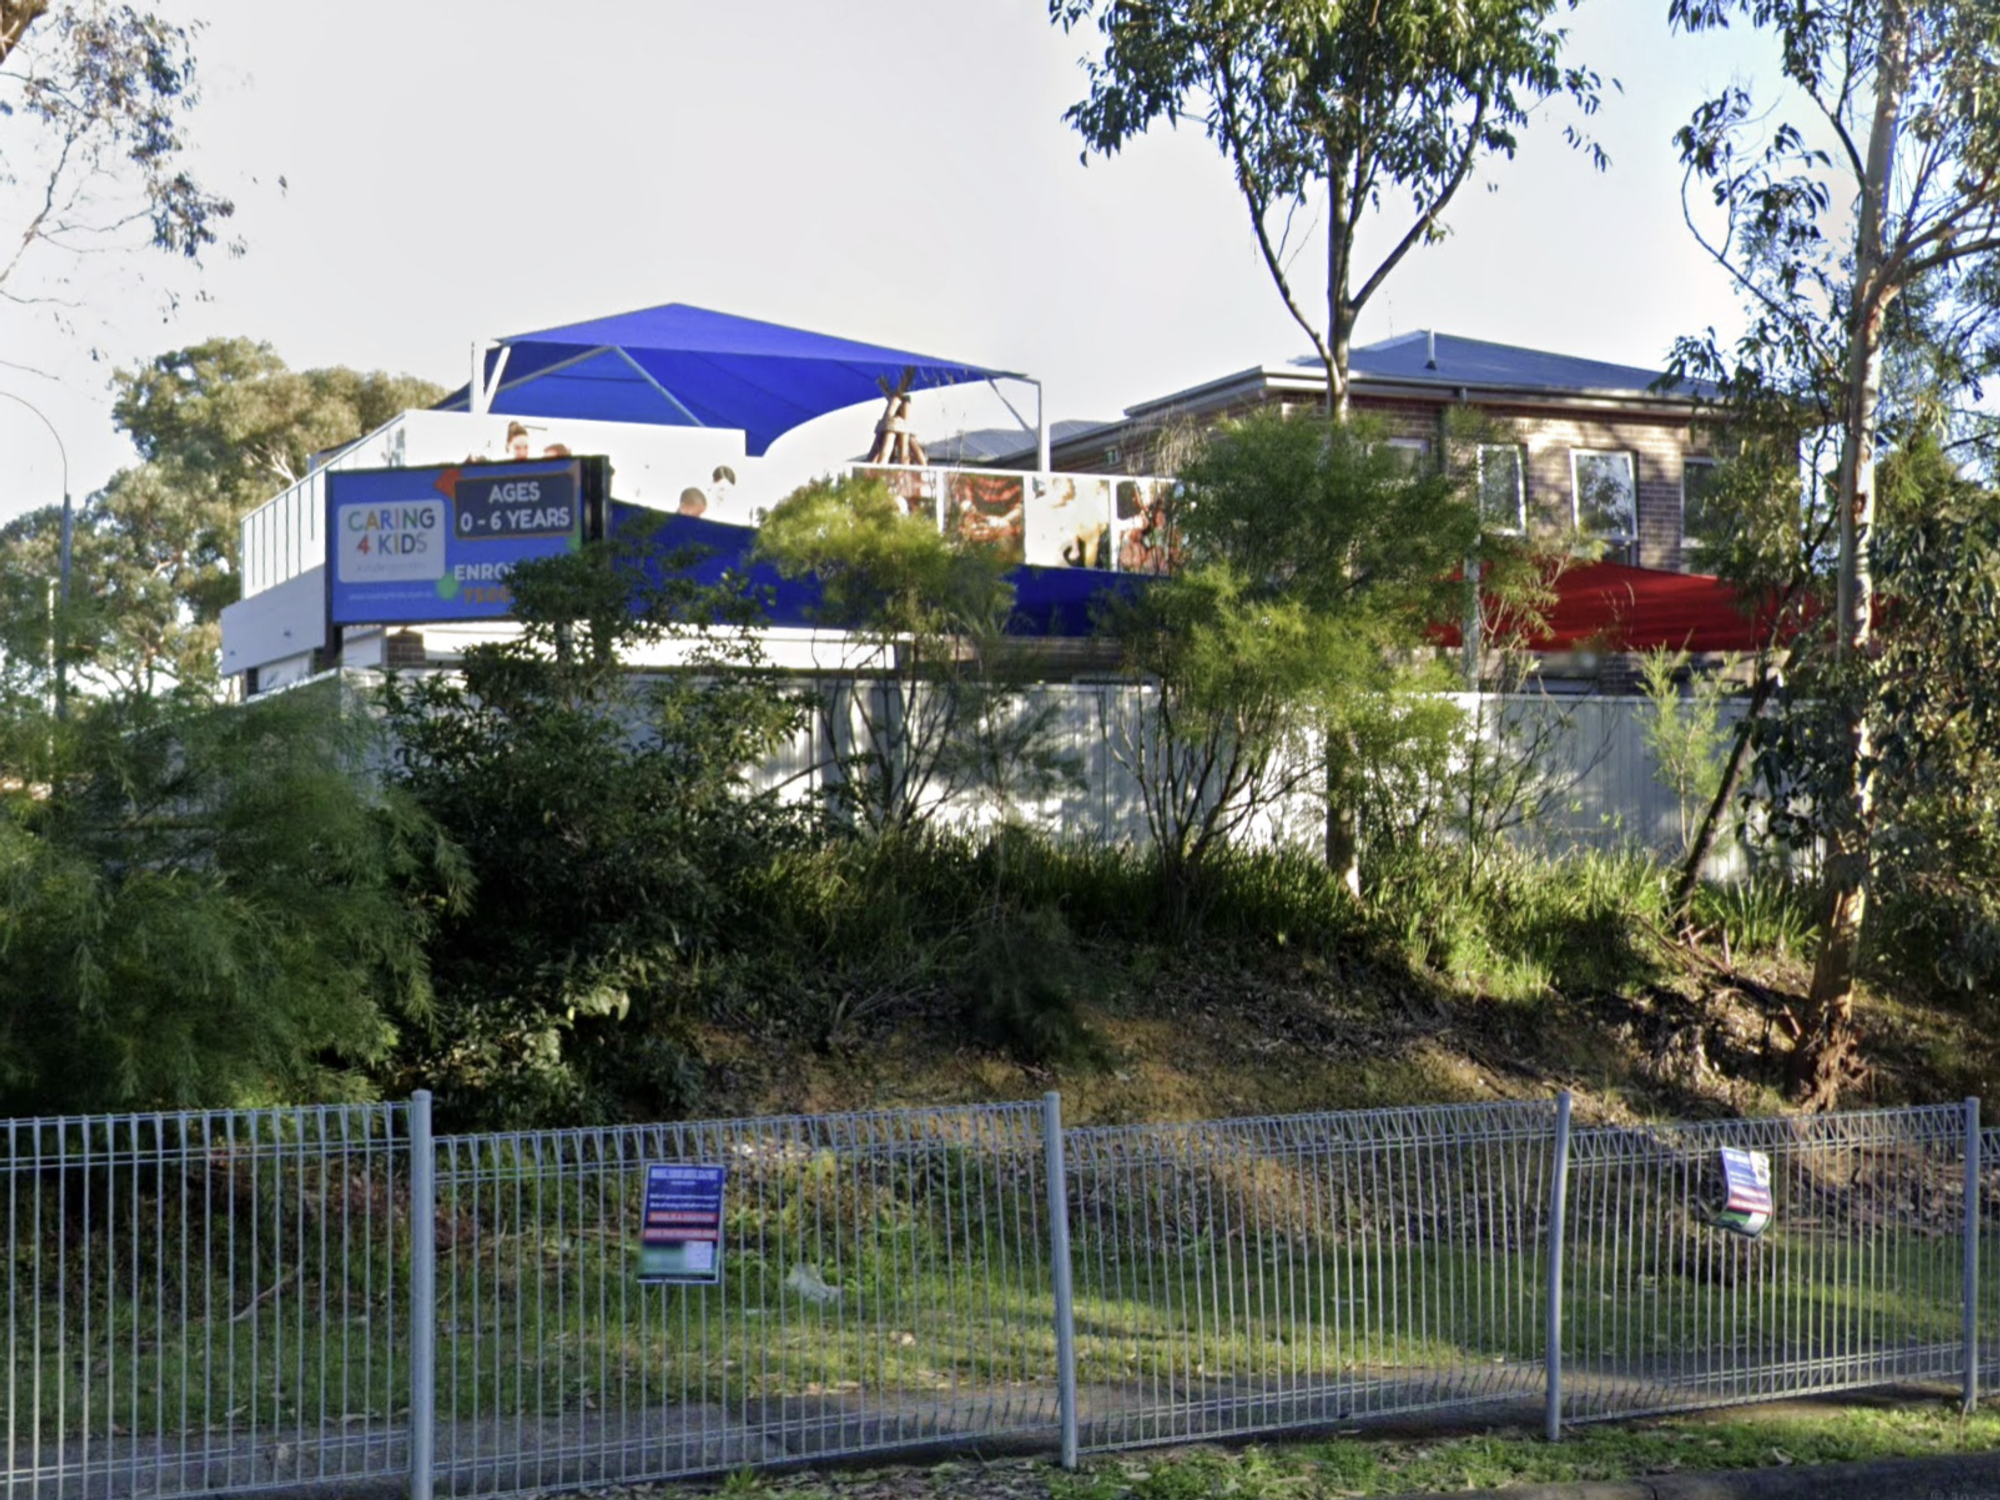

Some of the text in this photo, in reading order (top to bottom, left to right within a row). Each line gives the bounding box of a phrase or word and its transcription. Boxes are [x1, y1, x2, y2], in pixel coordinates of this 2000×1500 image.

[488, 481, 541, 505] AGES
[348, 507, 435, 532] CARING
[460, 512, 473, 532] 0
[490, 511, 502, 531] 6
[506, 507, 570, 530] YEARS
[356, 532, 427, 555] 4 KIDS
